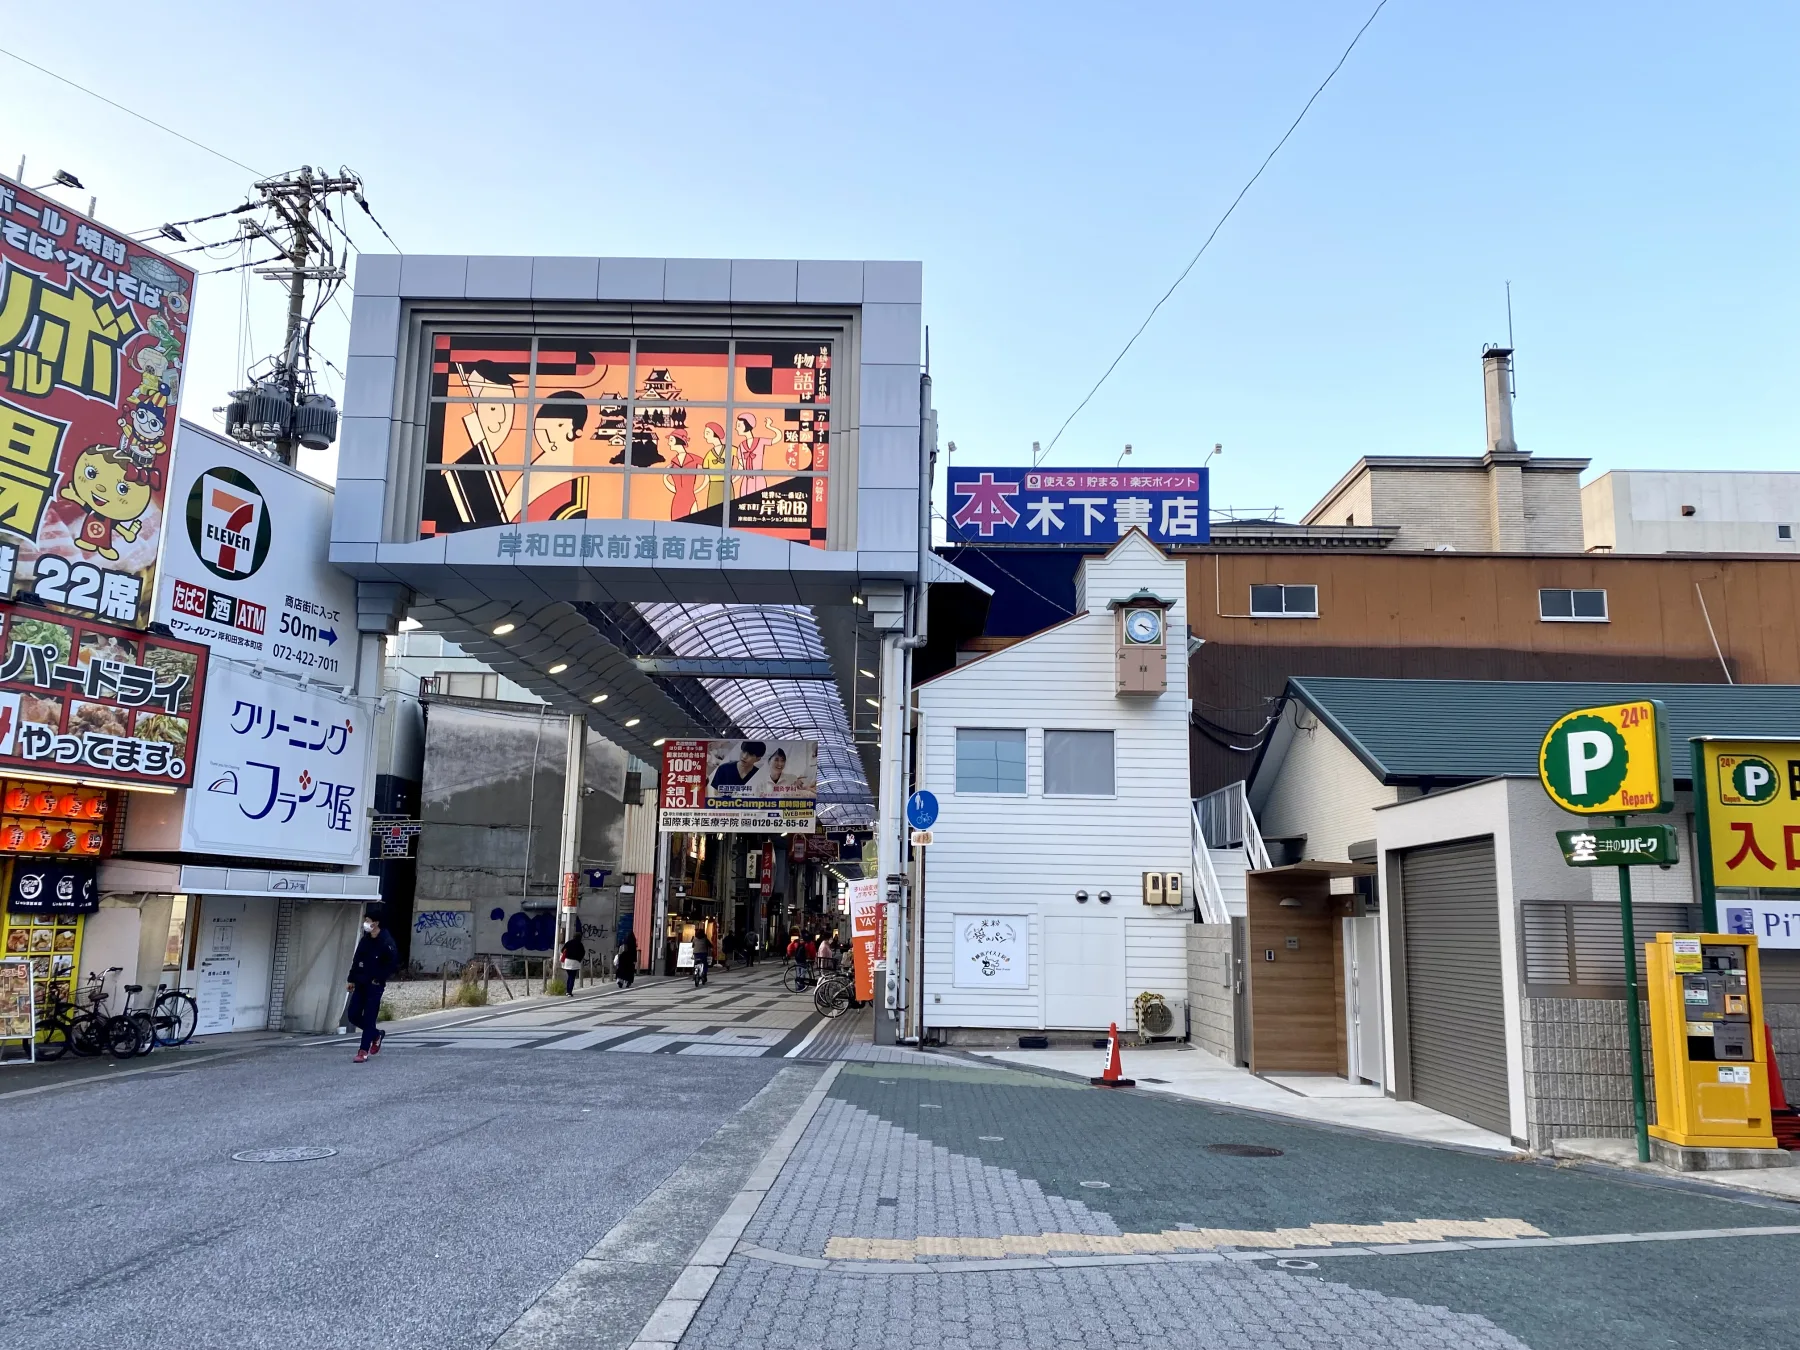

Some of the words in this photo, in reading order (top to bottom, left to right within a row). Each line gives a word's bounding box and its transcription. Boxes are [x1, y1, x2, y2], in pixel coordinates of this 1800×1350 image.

[76, 224, 127, 265] 焼酎
[0, 217, 163, 308] そば・オムそば
[793, 353, 815, 400] 物語は
[785, 430, 799, 466] 始まった
[761, 491, 808, 499] 世界に一番近い
[1043, 475, 1196, 488] 使える！貯まる！楽天ポイント
[738, 503, 760, 511] 城下町
[759, 499, 808, 516] 岸和田
[952, 473, 1021, 537] 本
[1026, 496, 1199, 537] 木下書店
[496, 532, 741, 562] 岸和田駅前通商店街
[36, 556, 140, 622] 22席
[173, 583, 205, 614] たばこ
[210, 594, 232, 623] 酒
[237, 604, 265, 633] ATM
[284, 594, 341, 622] 商店街に入って
[279, 611, 318, 642] 50m
[272, 643, 339, 673] 072-422-7011
[0, 642, 188, 714] パードライ
[230, 700, 354, 756] クリーニング
[1620, 706, 1648, 729] 24h
[20, 721, 186, 779] やってます。
[667, 758, 702, 772] 100%
[1566, 729, 1614, 796] P
[665, 786, 686, 797] 全国
[667, 772, 702, 785] 2年連続
[1743, 765, 1770, 797] P
[239, 760, 356, 832] フランス屋
[665, 787, 700, 808] NO.1
[707, 798, 777, 809] OpenCampus
[1621, 789, 1655, 807] Repark
[662, 817, 739, 827] 国際東洋医療学院
[752, 819, 809, 828] 0120-62-65-62
[1570, 833, 1598, 861] 空
[1598, 837, 1658, 853] 三井のリパーク
